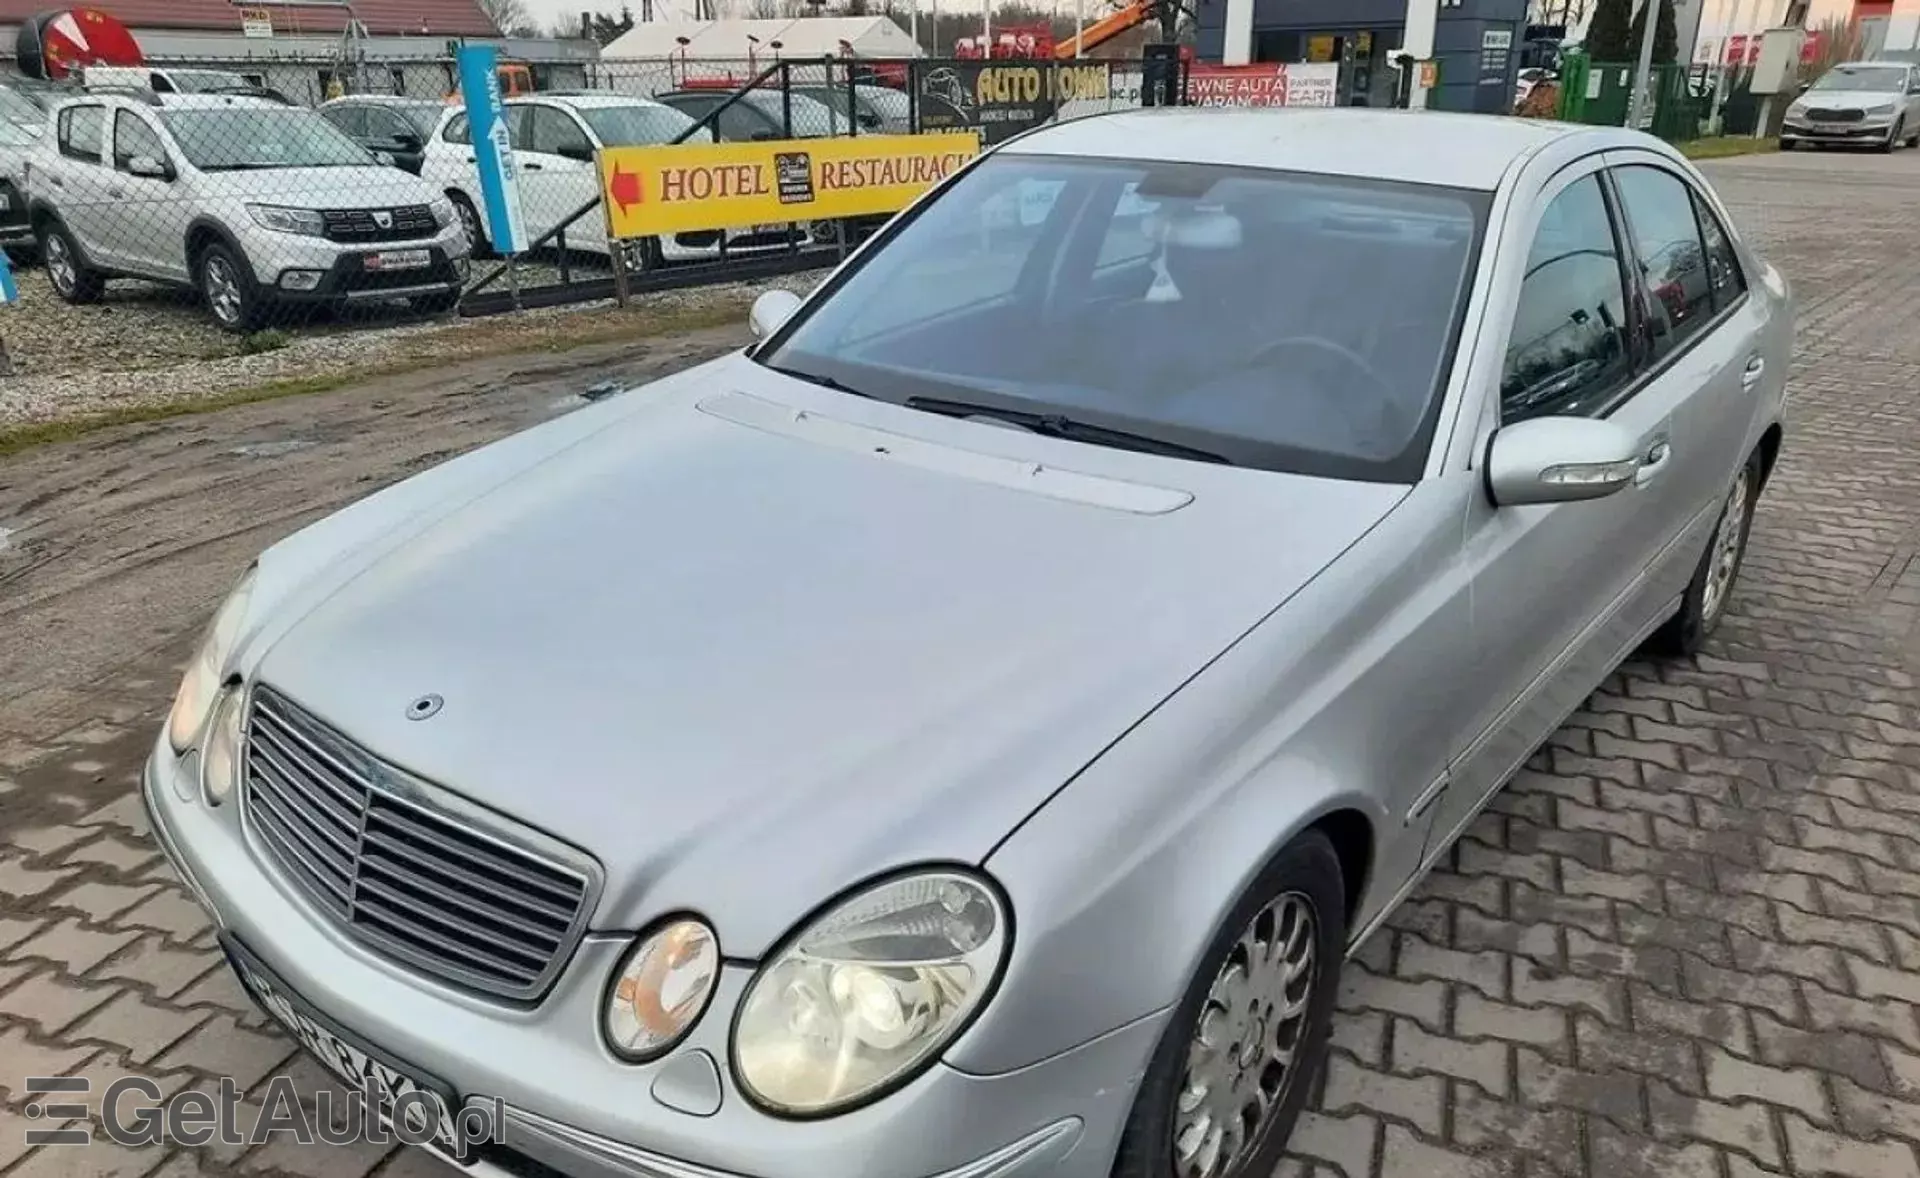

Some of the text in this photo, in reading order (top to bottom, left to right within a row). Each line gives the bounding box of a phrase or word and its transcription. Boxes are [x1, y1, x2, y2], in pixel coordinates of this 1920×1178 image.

[484, 70, 502, 112] BANK
[977, 67, 1040, 105] AUTO
[1180, 77, 1285, 93] EWNE AUTA
[660, 164, 770, 201] HOTEL
